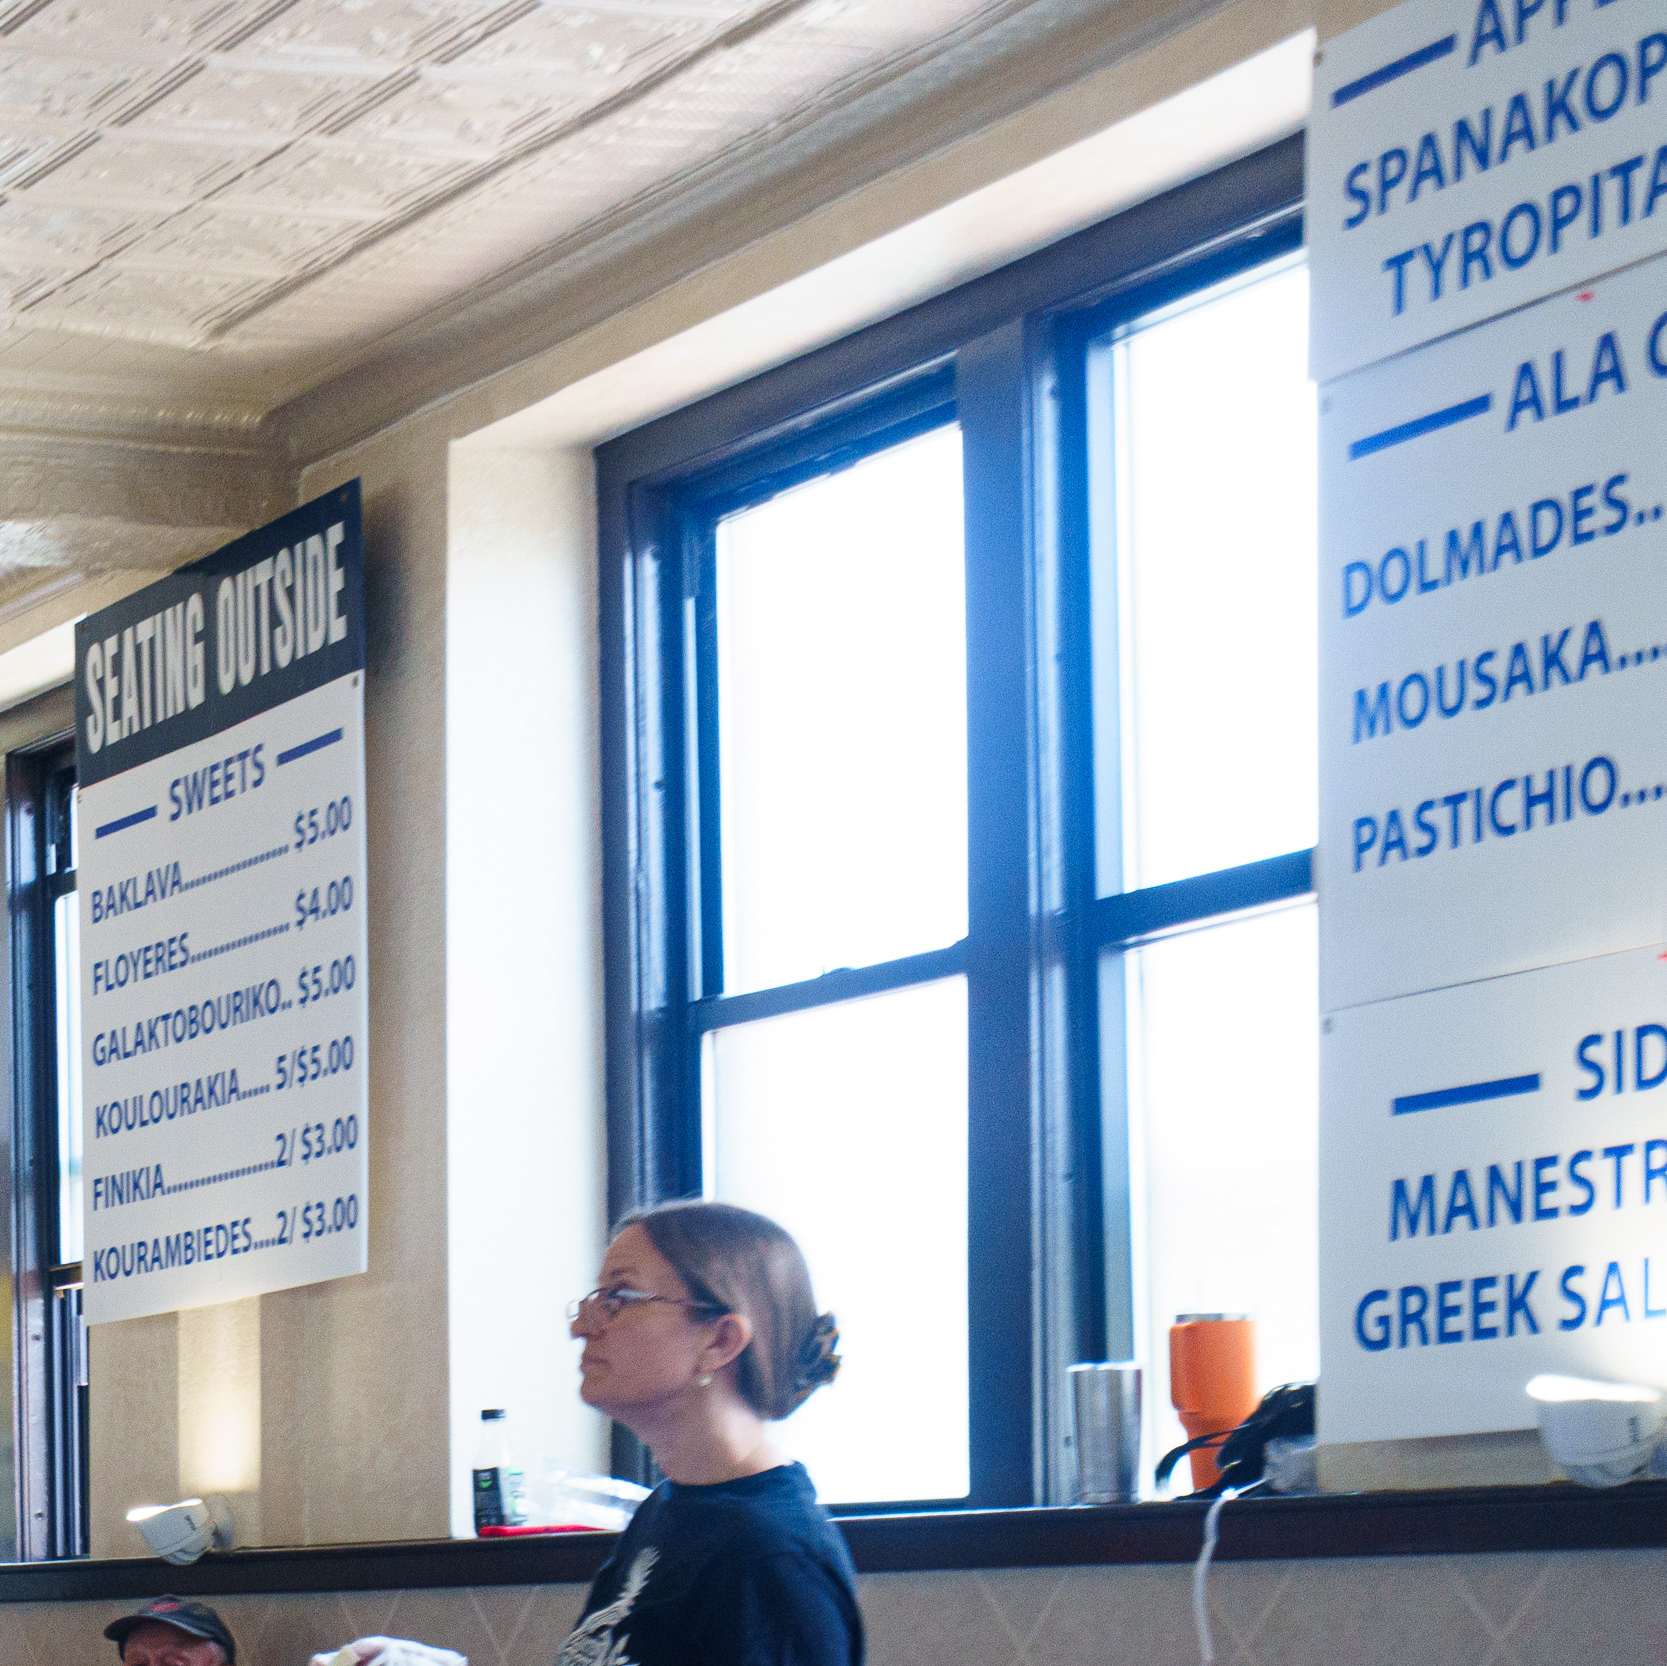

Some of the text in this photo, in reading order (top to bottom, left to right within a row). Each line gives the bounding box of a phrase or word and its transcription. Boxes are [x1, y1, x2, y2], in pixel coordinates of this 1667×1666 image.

[1467, 0, 1624, 68] AP
[1342, 32, 1667, 230] SPANAKOP
[1503, 329, 1629, 434] ALA
[85, 520, 348, 754] SEATING OUTSIDE
[169, 742, 266, 823] SWEETS
[294, 794, 353, 853] $5.00
[295, 874, 354, 931] $4.00
[298, 954, 356, 1009] $5.00
[301, 1112, 359, 1165] $3.00
[301, 1192, 359, 1244] $3.00
[1353, 1256, 1667, 1352] GREEK SAL
